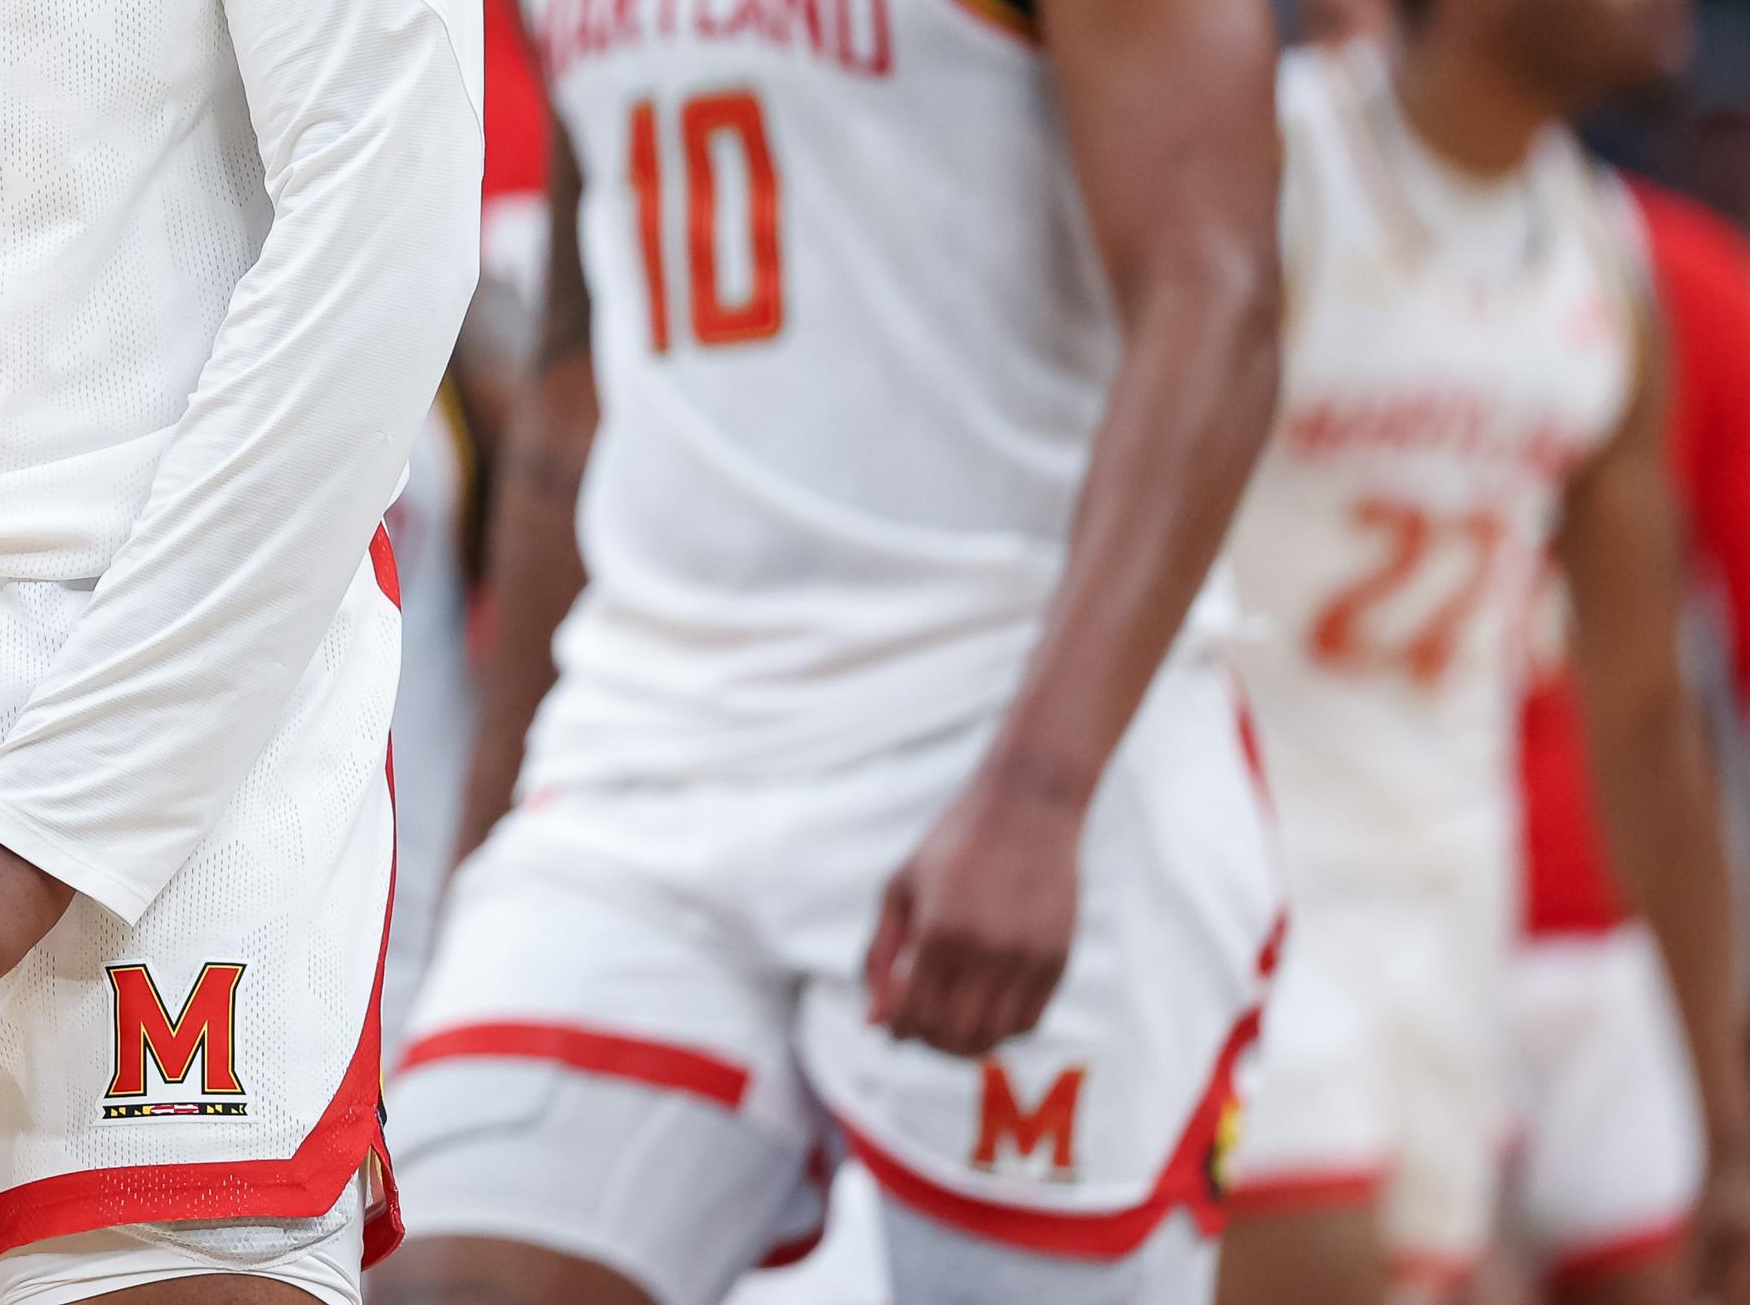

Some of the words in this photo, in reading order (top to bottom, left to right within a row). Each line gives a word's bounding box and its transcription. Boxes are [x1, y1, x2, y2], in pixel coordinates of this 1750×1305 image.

[626, 88, 786, 357] 10
[104, 961, 248, 1099] M
[968, 1059, 1087, 1179] M
